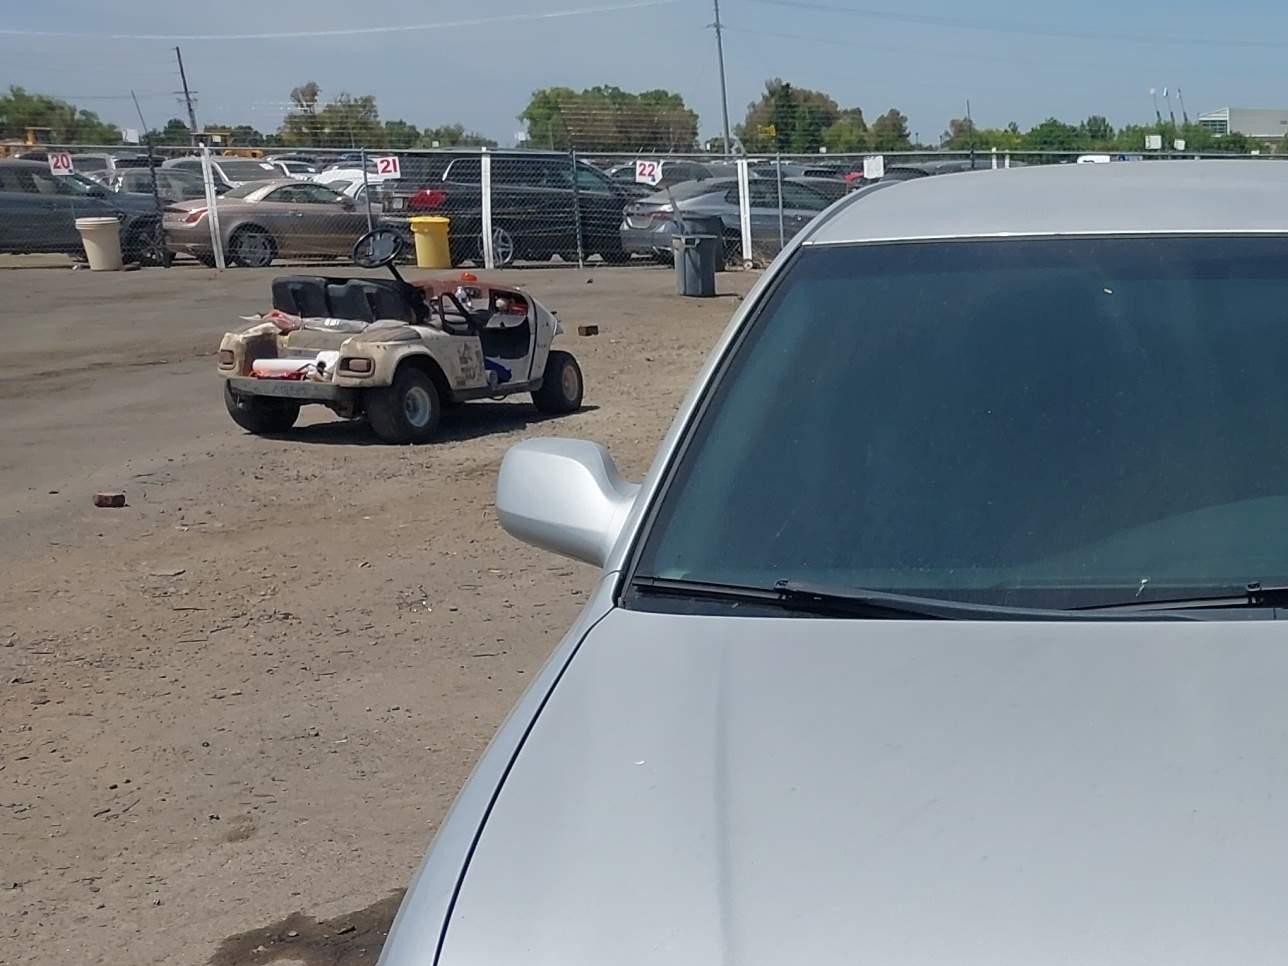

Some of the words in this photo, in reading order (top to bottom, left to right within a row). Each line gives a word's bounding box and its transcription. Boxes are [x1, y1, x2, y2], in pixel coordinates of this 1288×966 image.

[51, 153, 70, 169] 20
[380, 158, 398, 173] 21
[638, 162, 656, 177] 22
